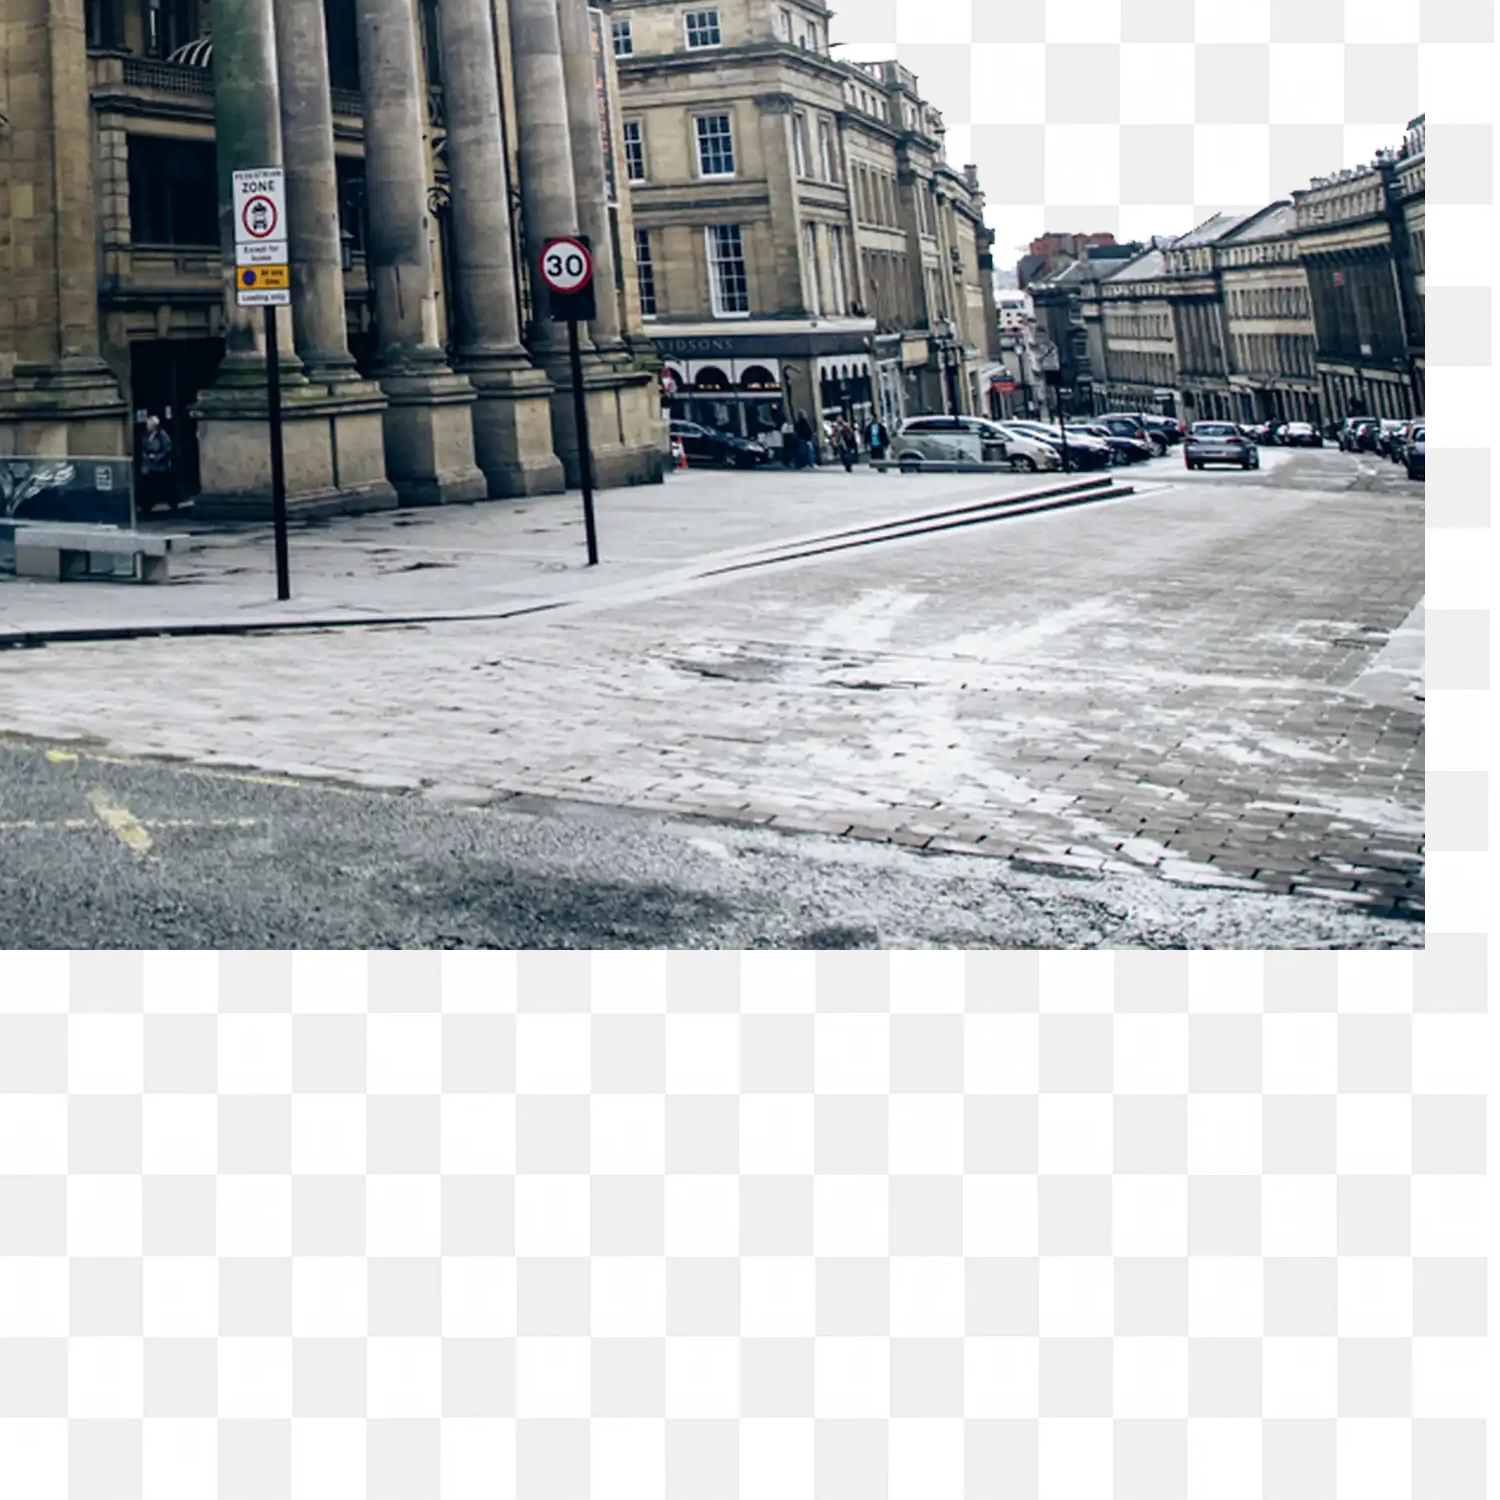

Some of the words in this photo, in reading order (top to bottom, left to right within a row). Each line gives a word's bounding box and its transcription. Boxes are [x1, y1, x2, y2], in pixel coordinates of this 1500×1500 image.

[235, 170, 281, 180] PEDESTRIAN
[242, 181, 275, 193] ZONE
[547, 254, 583, 277] 30
[242, 293, 269, 303] Loading
